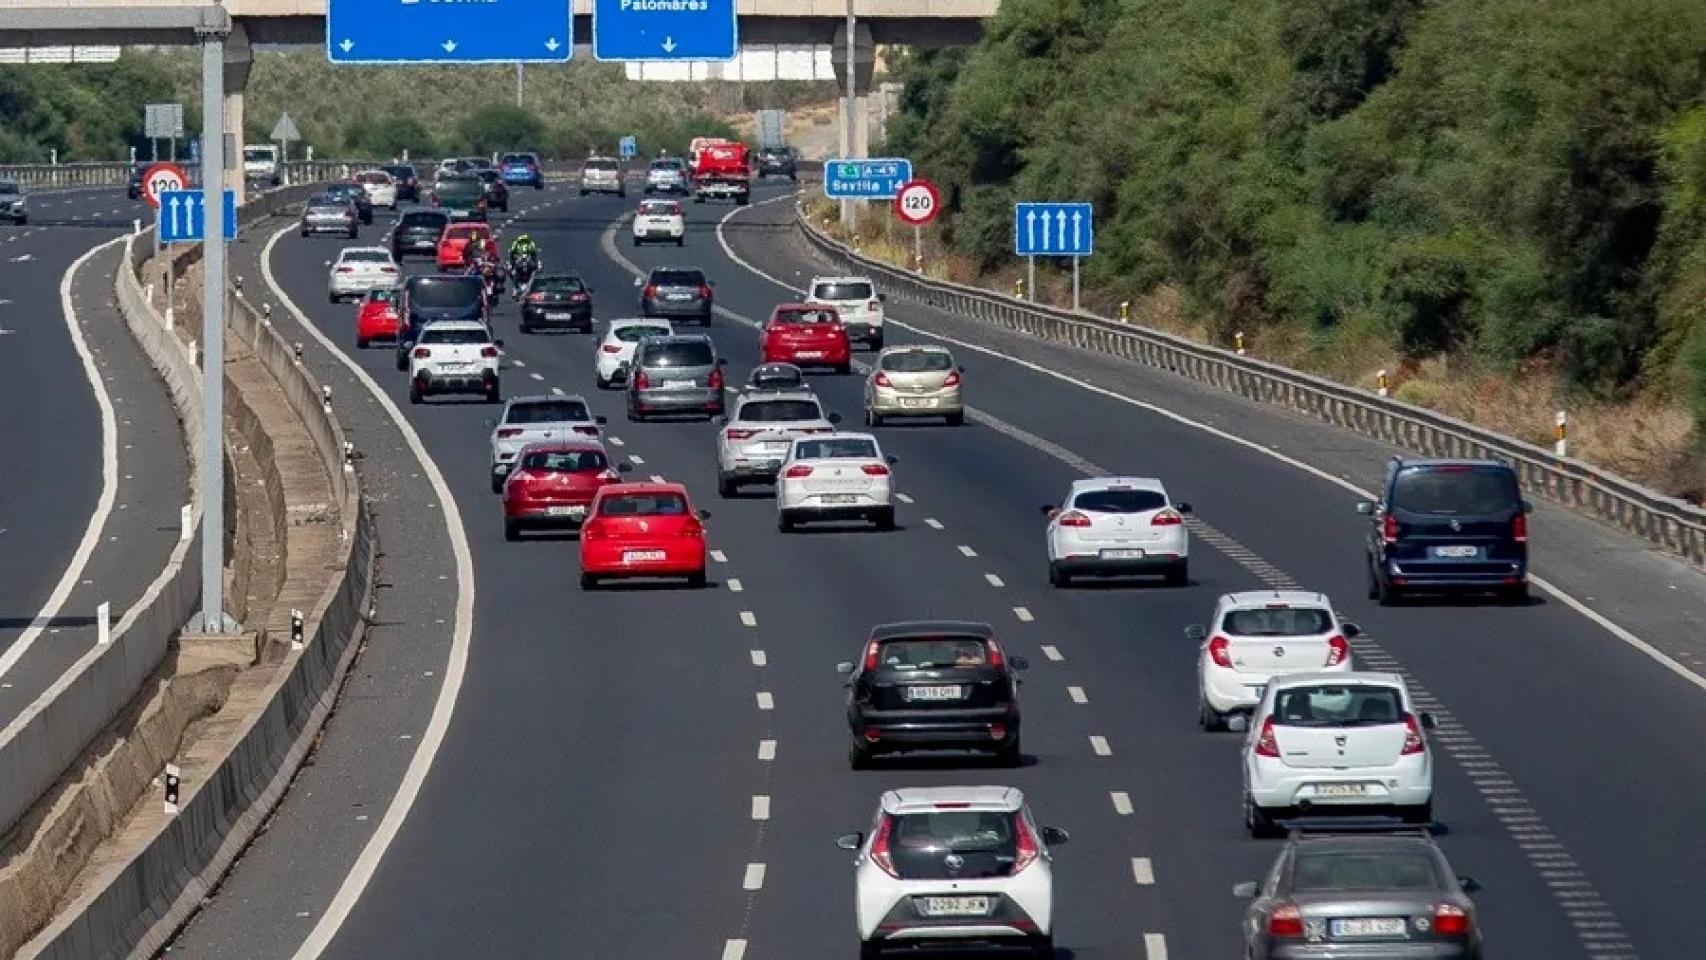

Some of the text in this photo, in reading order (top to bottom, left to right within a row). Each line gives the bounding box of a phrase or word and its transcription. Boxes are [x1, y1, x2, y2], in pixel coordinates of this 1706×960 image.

[621, 0, 708, 11] Palomares
[151, 179, 179, 194] 120
[833, 179, 906, 191] Sevilla 14
[905, 196, 931, 209] 120
